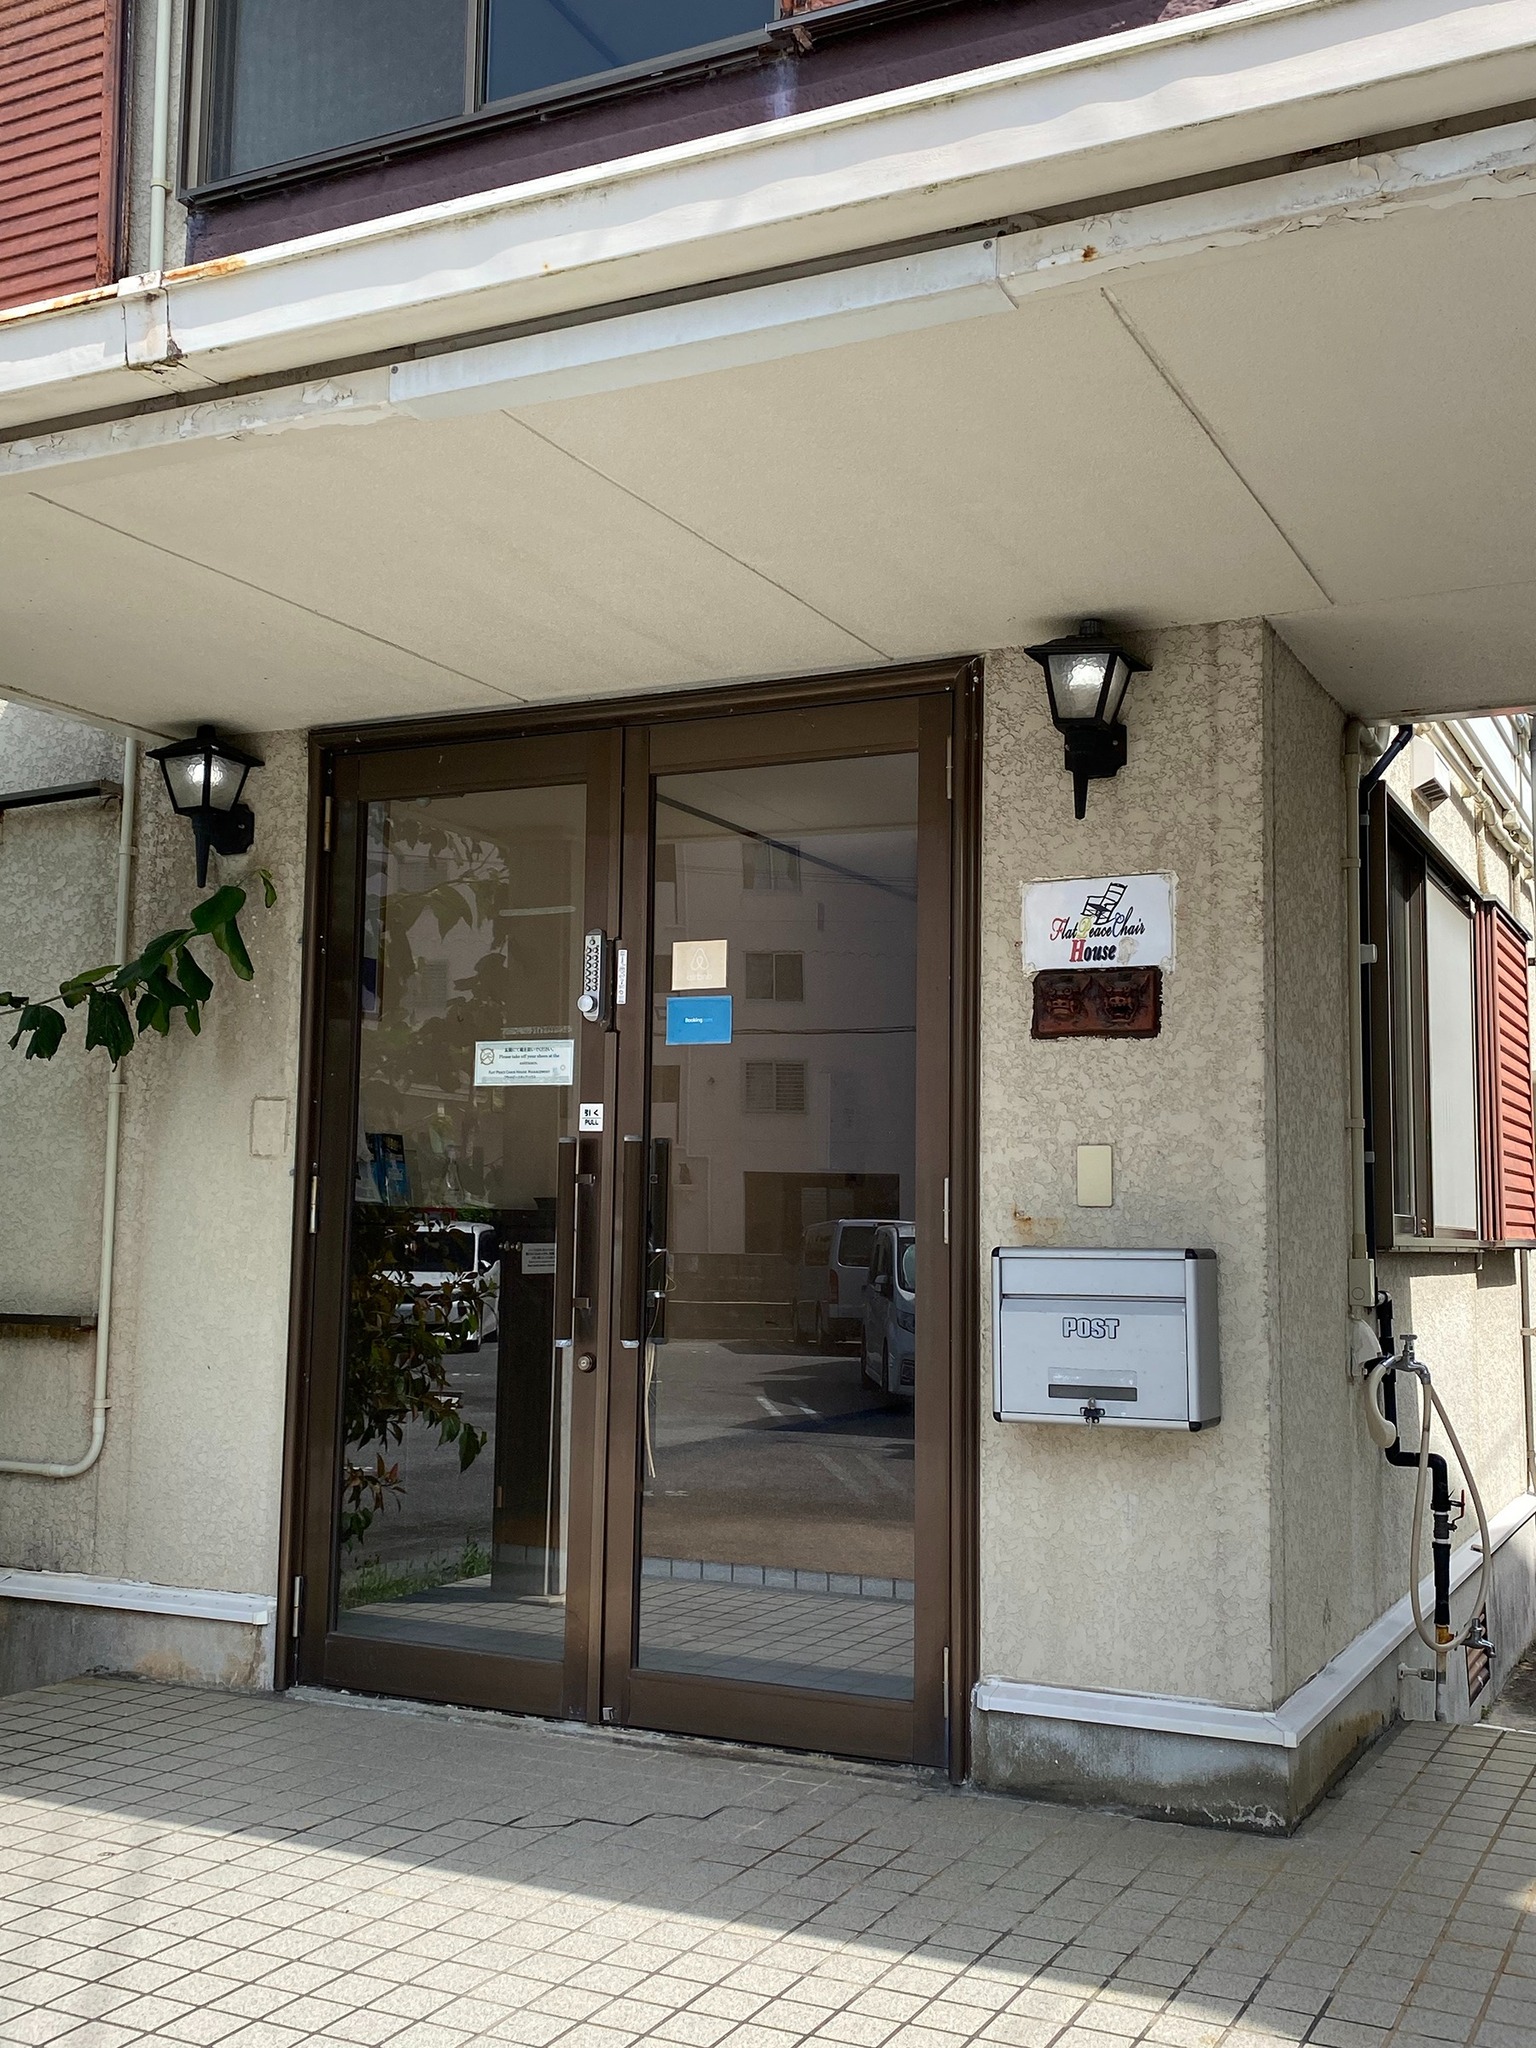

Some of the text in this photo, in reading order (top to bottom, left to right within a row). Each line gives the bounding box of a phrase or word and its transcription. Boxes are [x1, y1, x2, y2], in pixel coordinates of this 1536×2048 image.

[1050, 916, 1077, 941] Flat
[1111, 906, 1146, 938] Chair
[1069, 939, 1116, 962] House
[1062, 1317, 1120, 1340] POST
